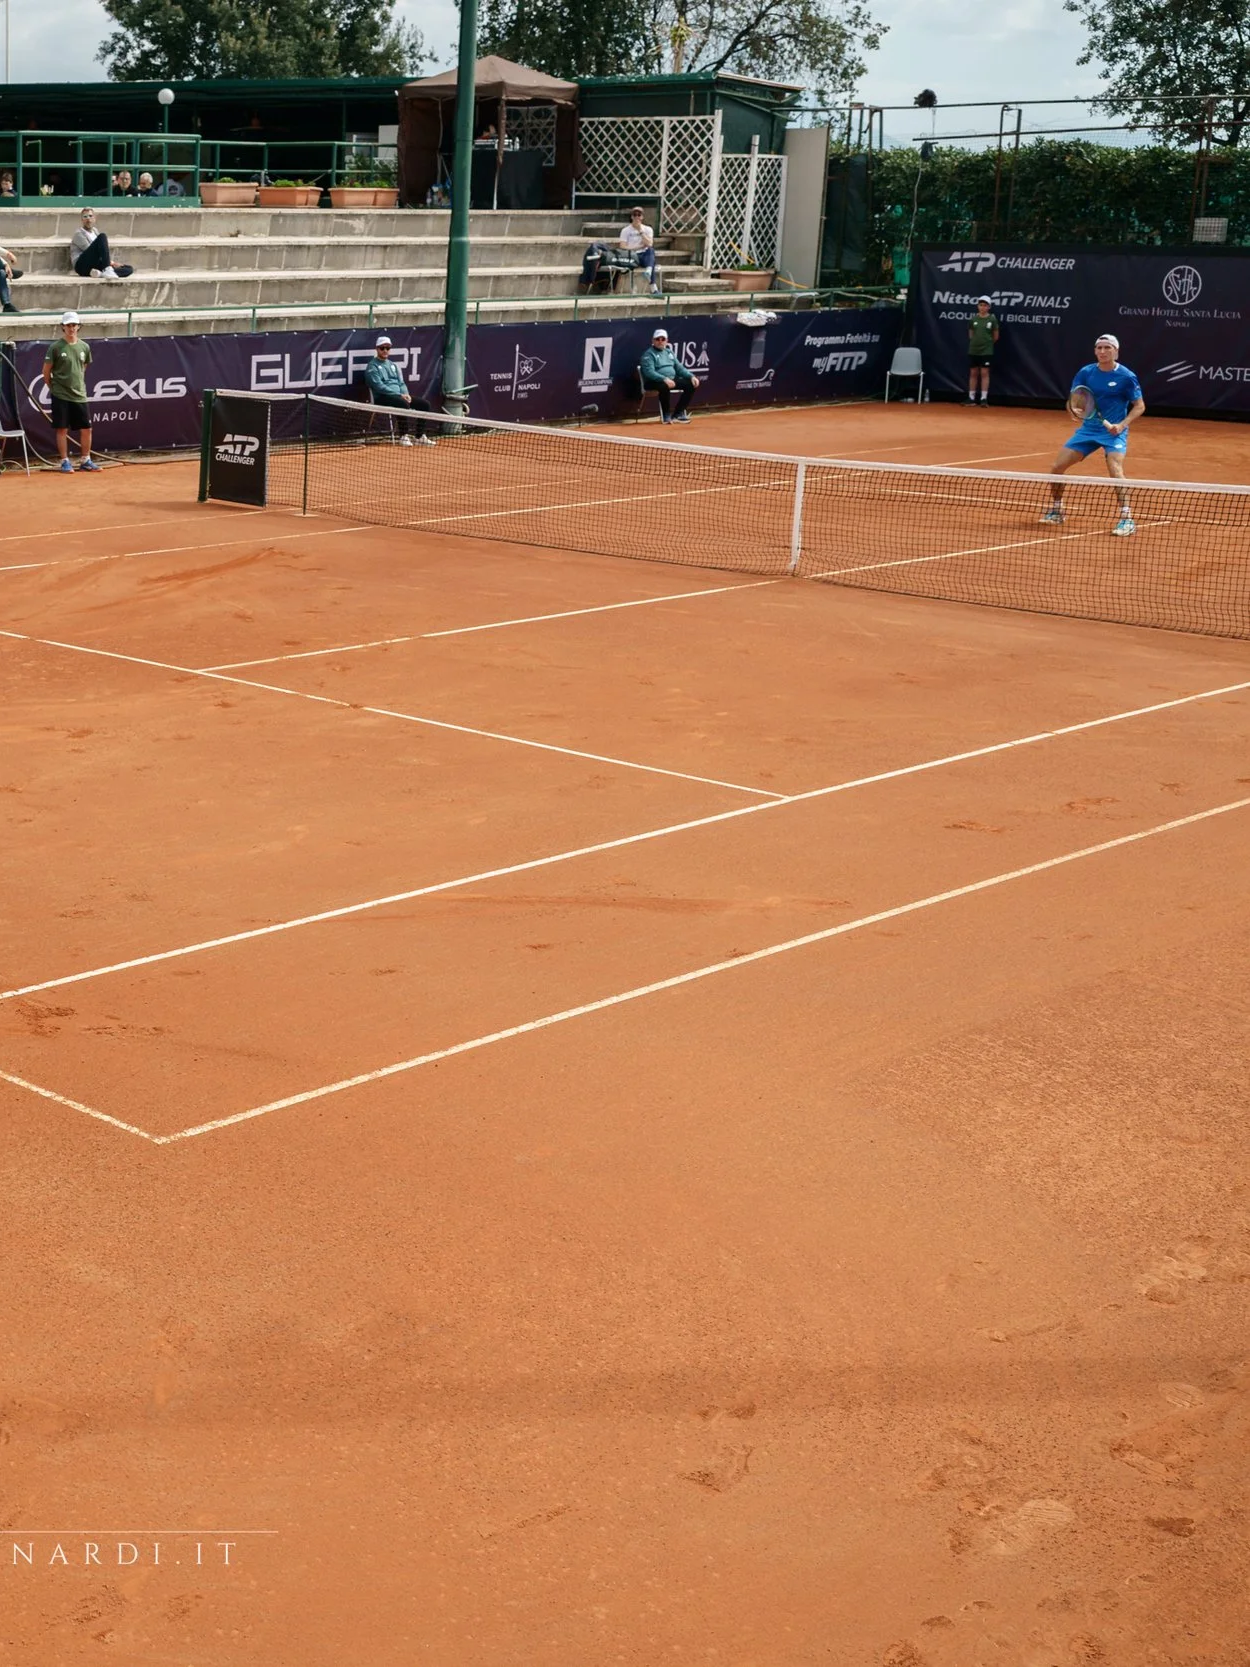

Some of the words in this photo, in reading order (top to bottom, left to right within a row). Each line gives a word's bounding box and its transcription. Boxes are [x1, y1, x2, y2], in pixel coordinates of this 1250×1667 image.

[937, 251, 996, 273] ATP
[997, 257, 1076, 270] CHALLENGER
[932, 291, 980, 305] Nitto
[990, 291, 1024, 307] ATP
[1024, 295, 1072, 309] FINALS
[1006, 314, 1061, 325] BIGLIETTI
[804, 335, 845, 348] Programma
[490, 372, 512, 380] TENNIS
[86, 376, 187, 403] EXUS
[494, 384, 511, 392] CLUB
[517, 383, 541, 391] NAPOLI
[214, 433, 260, 456] ATP
[215, 453, 255, 466] CHALLENGER
